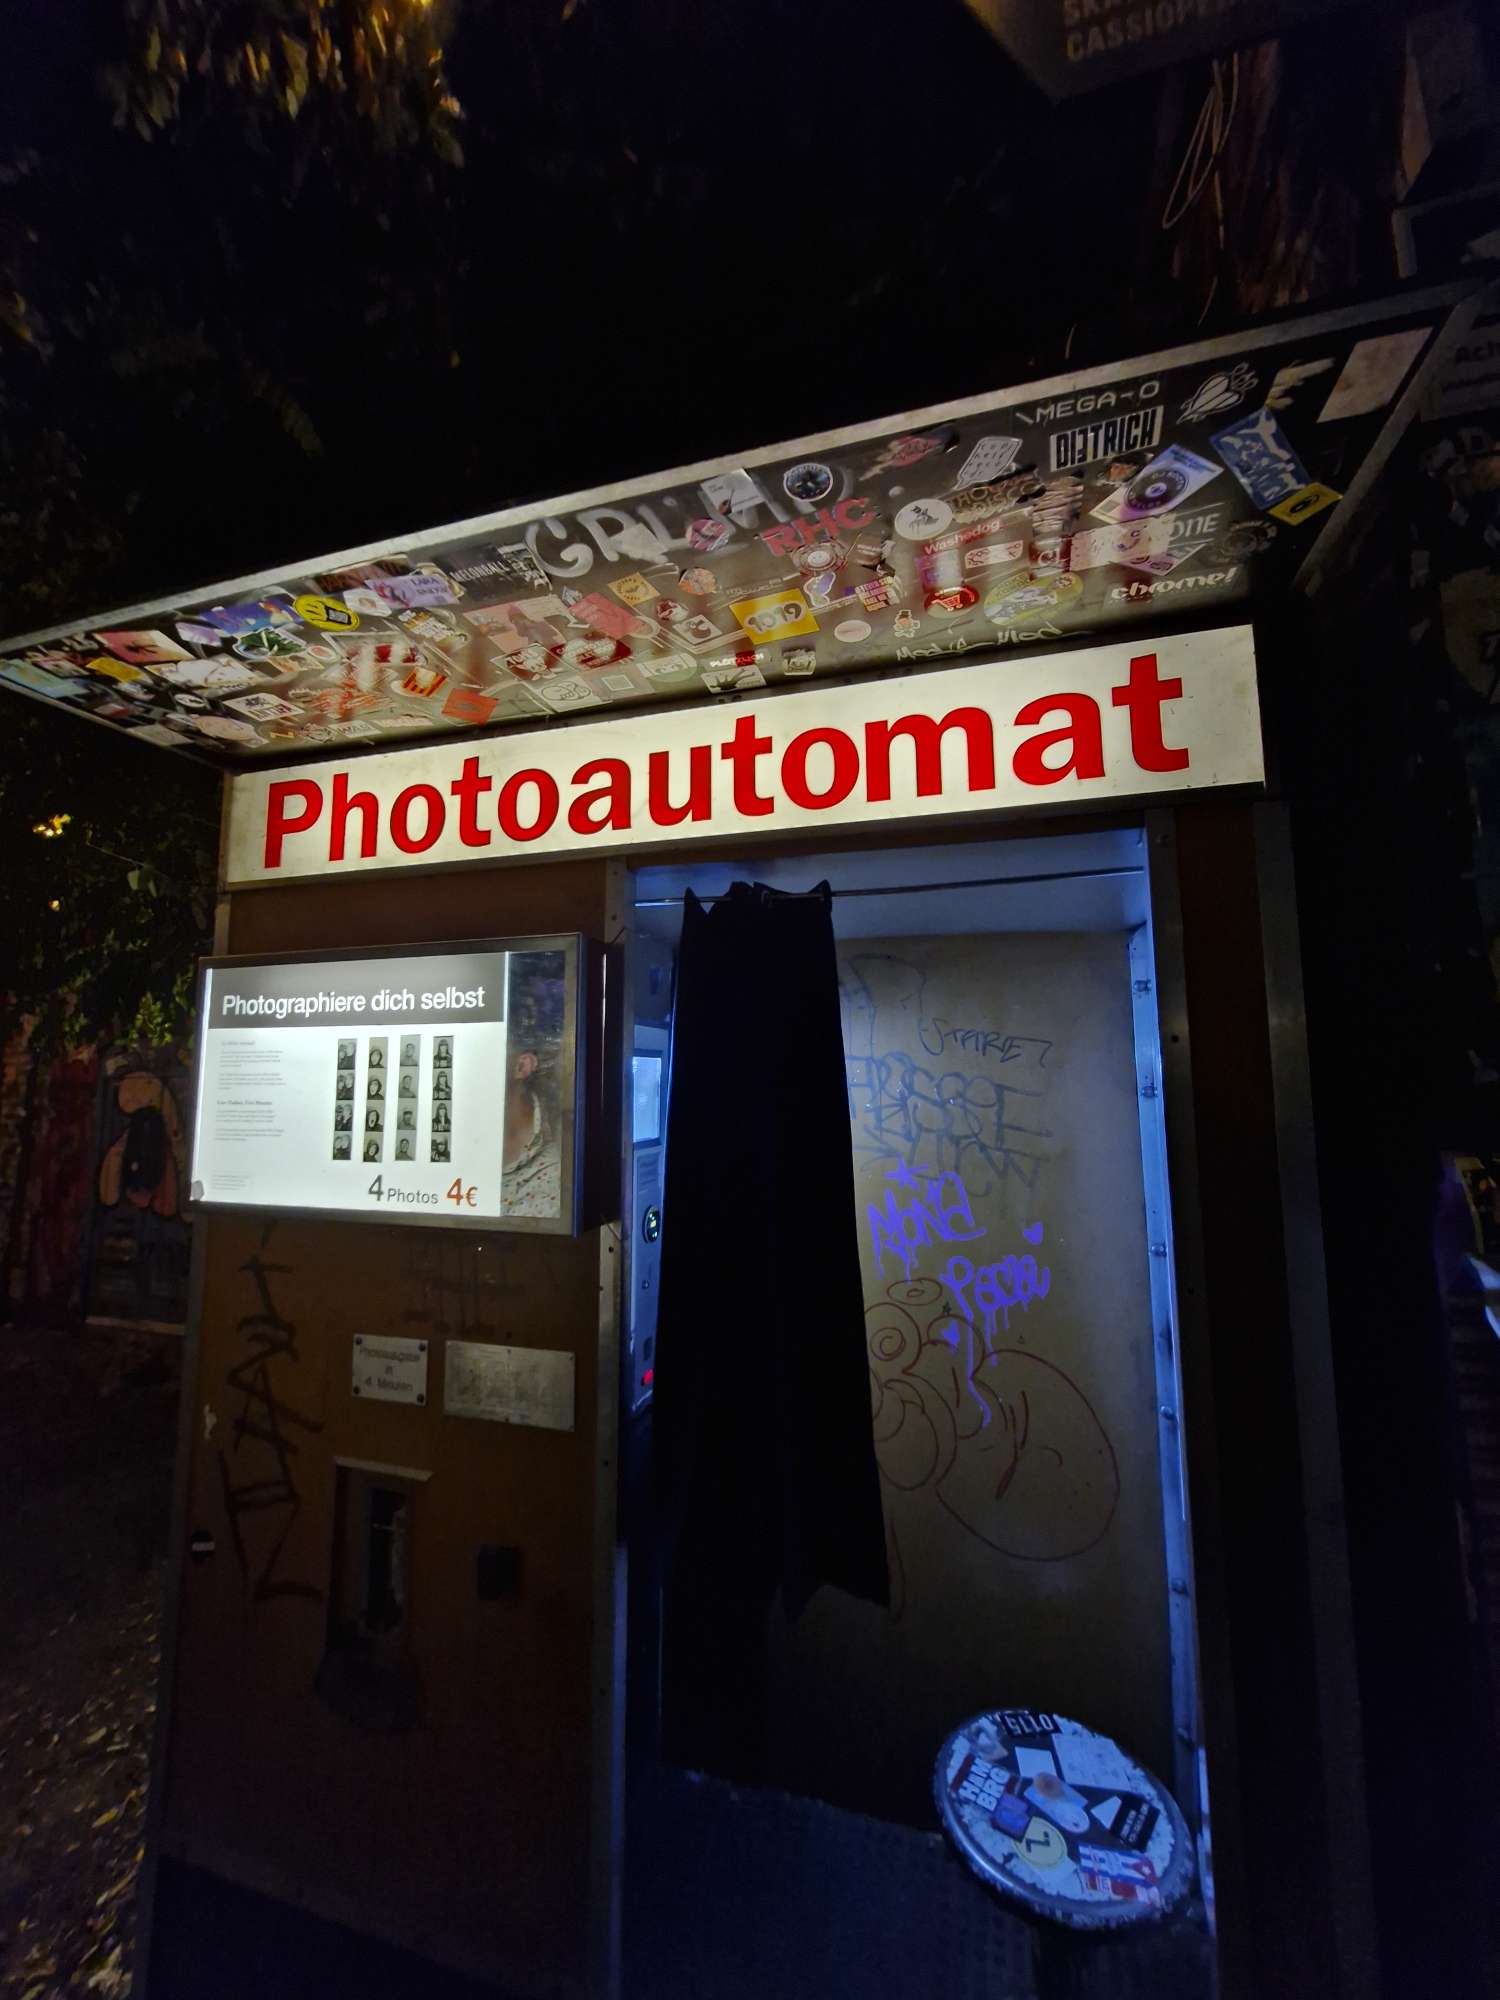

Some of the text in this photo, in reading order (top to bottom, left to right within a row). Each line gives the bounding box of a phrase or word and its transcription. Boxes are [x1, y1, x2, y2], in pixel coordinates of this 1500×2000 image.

[760, 496, 878, 558] RHC
[264, 653, 1190, 869] Photoautomat
[221, 986, 486, 1019] Photographiere dich selbst
[368, 1174, 479, 1208] 4 Photos 4€
